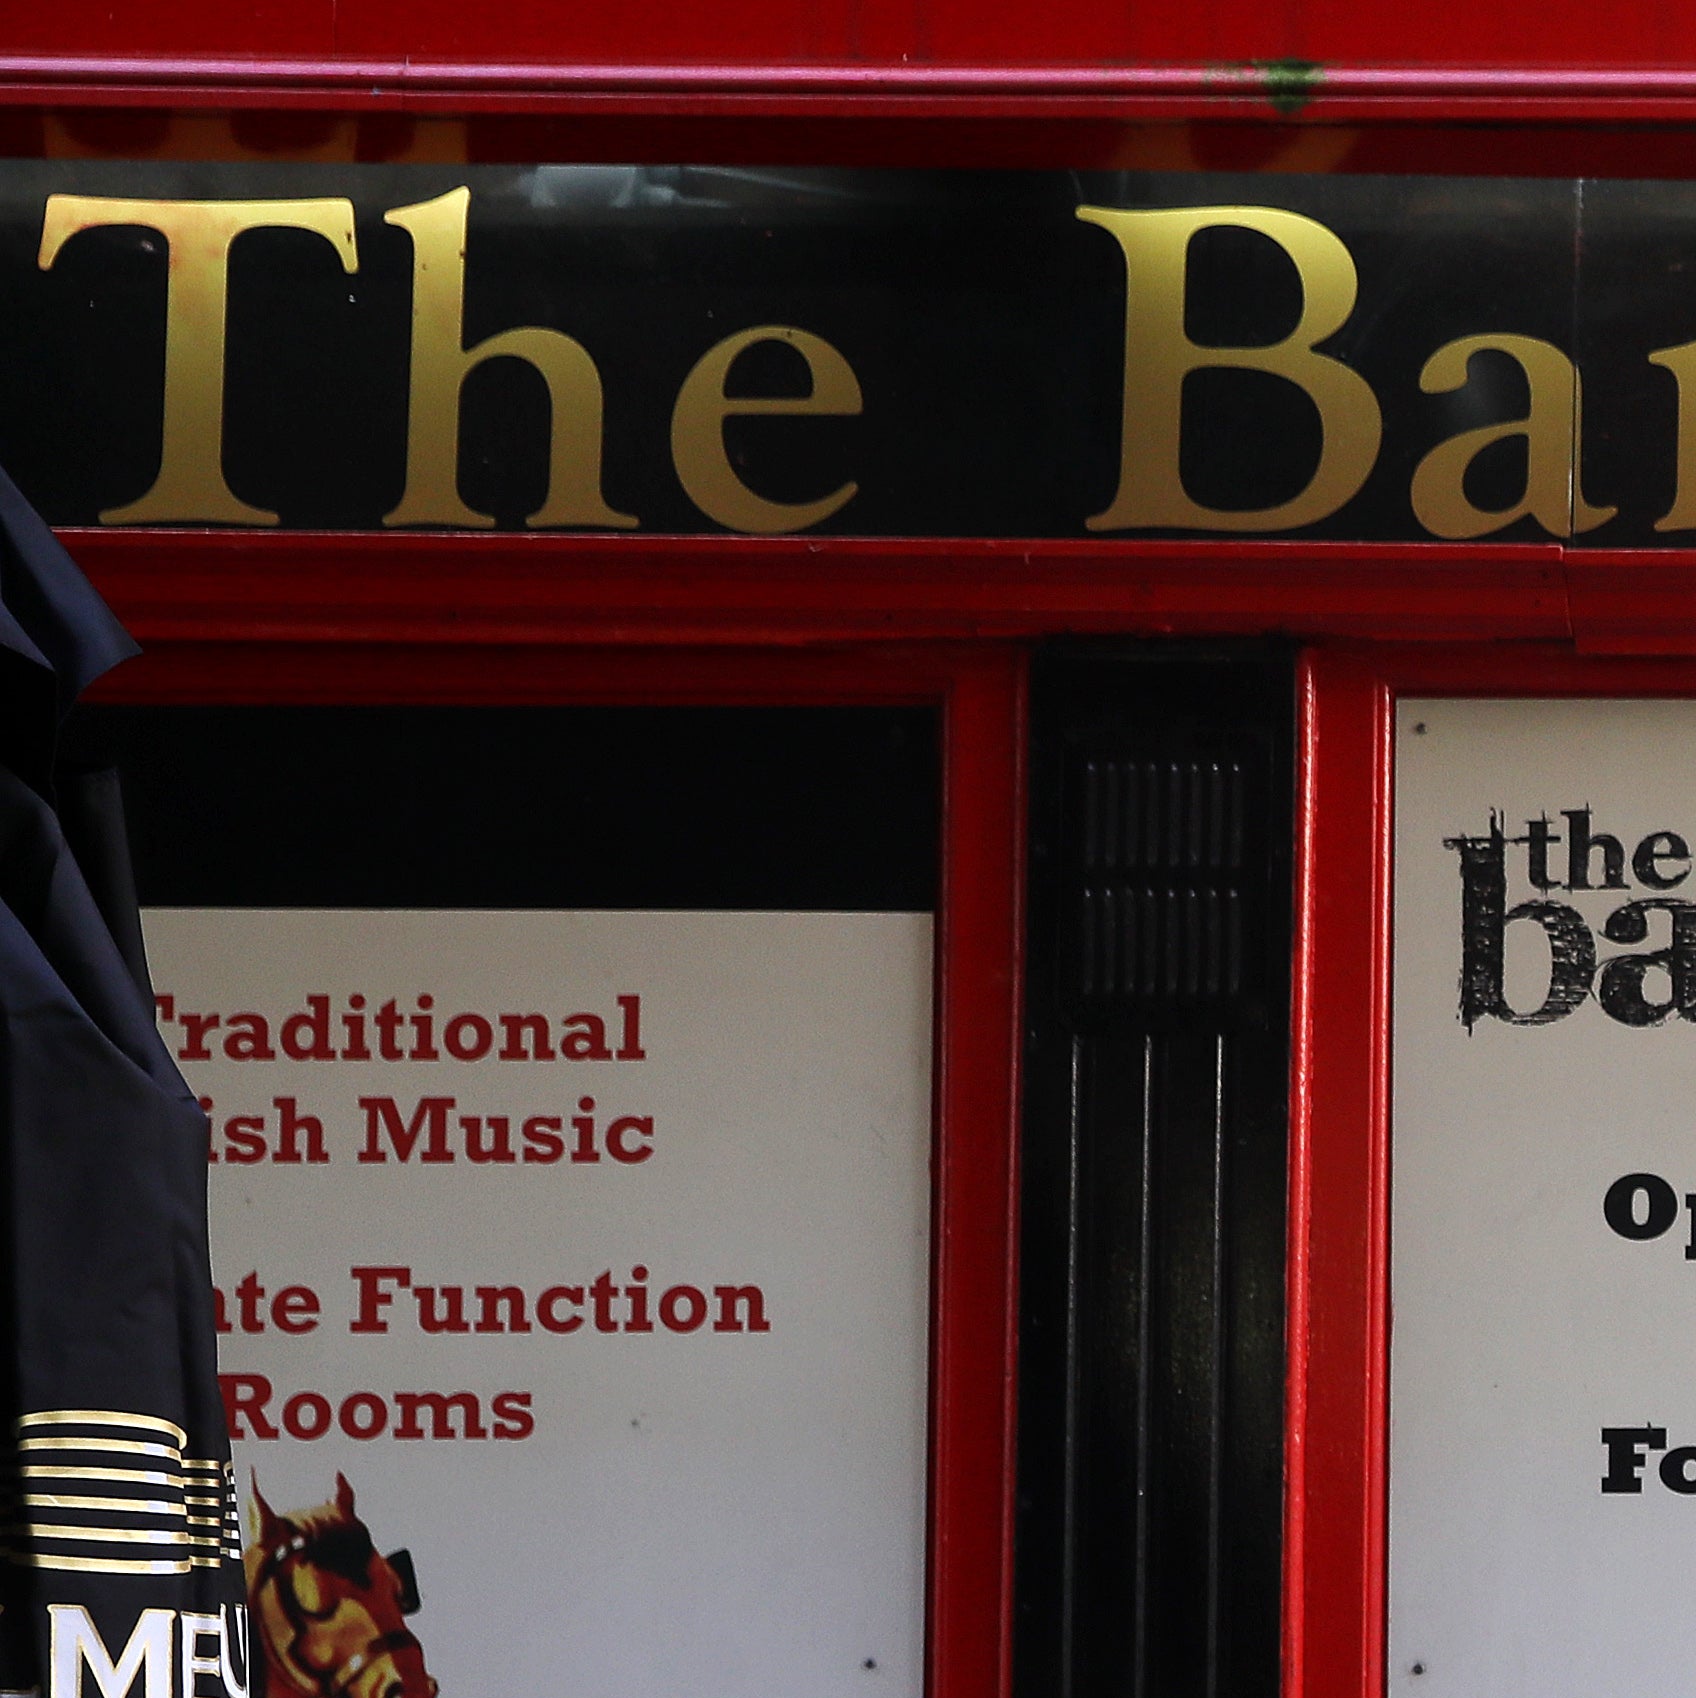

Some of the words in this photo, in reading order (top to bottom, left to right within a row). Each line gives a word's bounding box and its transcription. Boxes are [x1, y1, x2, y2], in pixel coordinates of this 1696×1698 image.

[37, 184, 862, 533] The
[1524, 802, 1695, 889] the
[359, 1096, 653, 1164] Music
[351, 1266, 770, 1333] Function
[218, 1374, 534, 1440] Rooms
